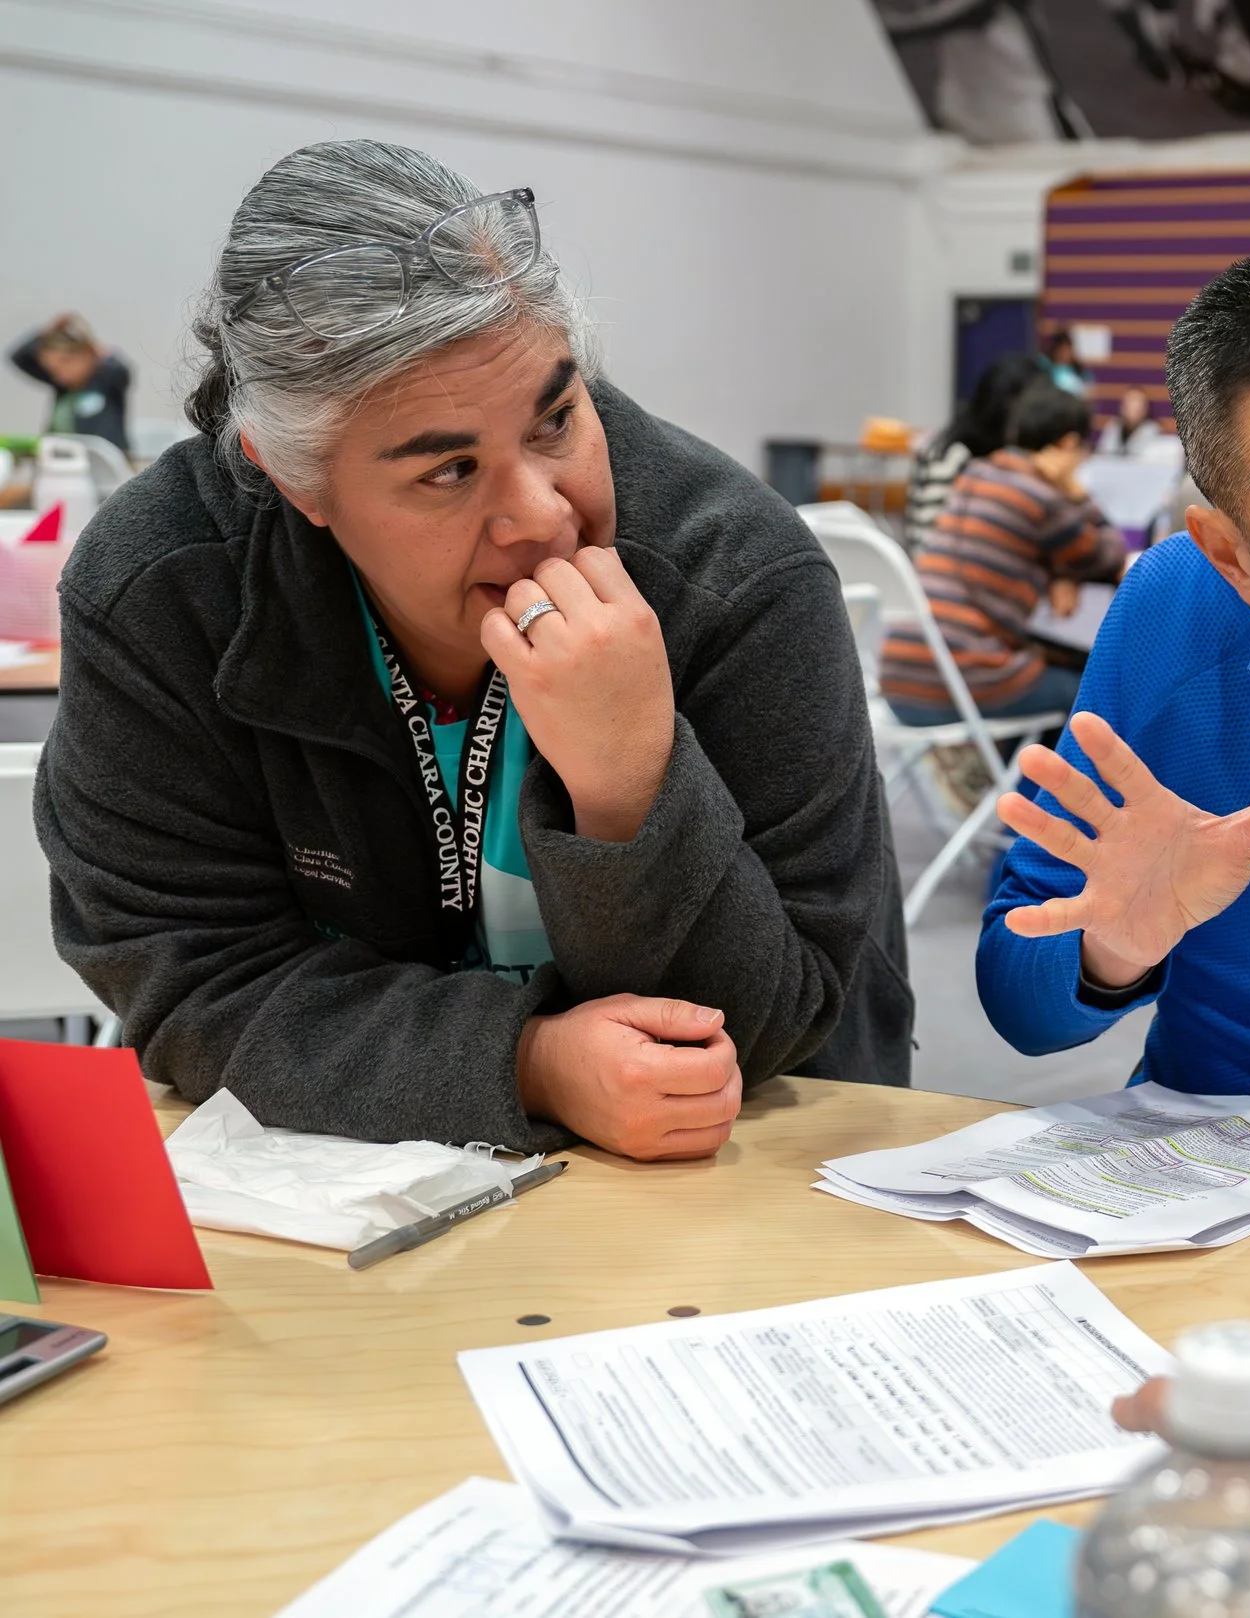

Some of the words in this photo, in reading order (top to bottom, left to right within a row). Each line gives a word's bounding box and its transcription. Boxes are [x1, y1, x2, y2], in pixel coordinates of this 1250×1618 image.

[376, 636, 418, 715] SANTA
[407, 714, 444, 806] CLARA
[432, 806, 463, 912] COUNTY
[470, 1195, 490, 1211] Round
[448, 1211, 456, 1220] M
[458, 1206, 470, 1216] Stic
